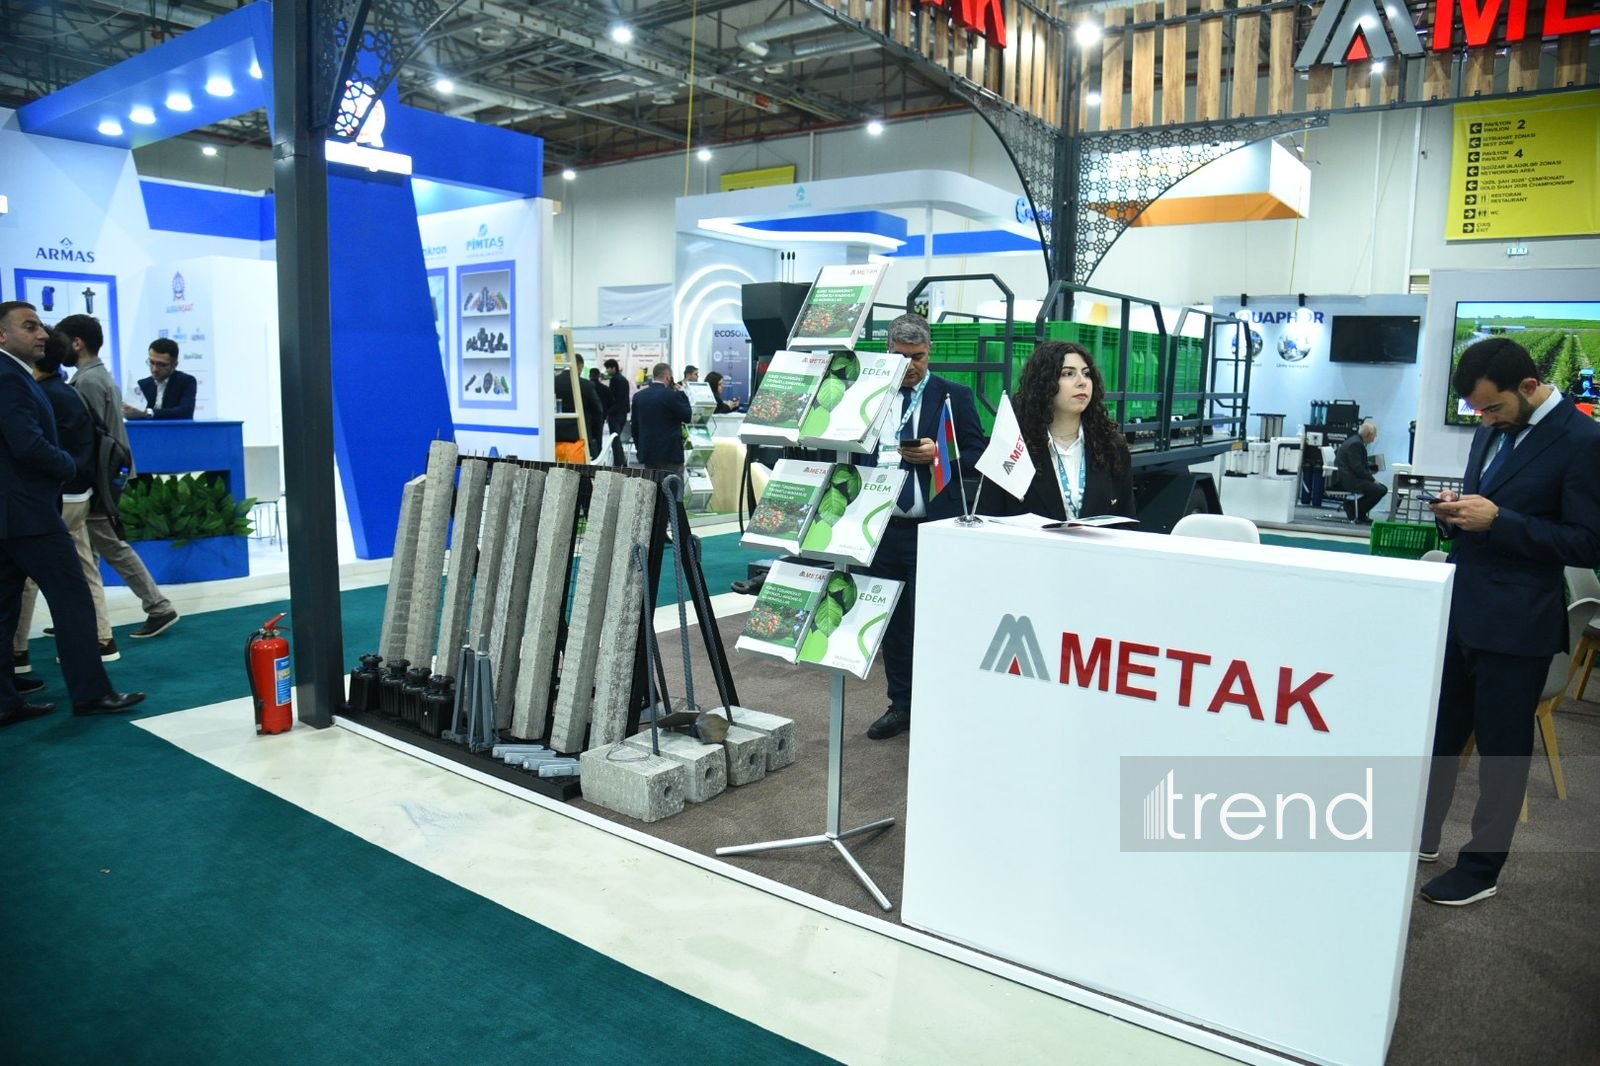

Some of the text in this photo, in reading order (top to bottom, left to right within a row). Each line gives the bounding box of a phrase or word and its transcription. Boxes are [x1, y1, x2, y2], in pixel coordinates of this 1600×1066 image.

[1517, 119, 1526, 130] 2
[1514, 149, 1523, 158] 4
[36, 247, 96, 263] ARMAS
[862, 367, 891, 376] EDEM
[863, 483, 892, 493] EDEM
[859, 592, 887, 604] EDEM
[1059, 631, 1335, 733] METAK
